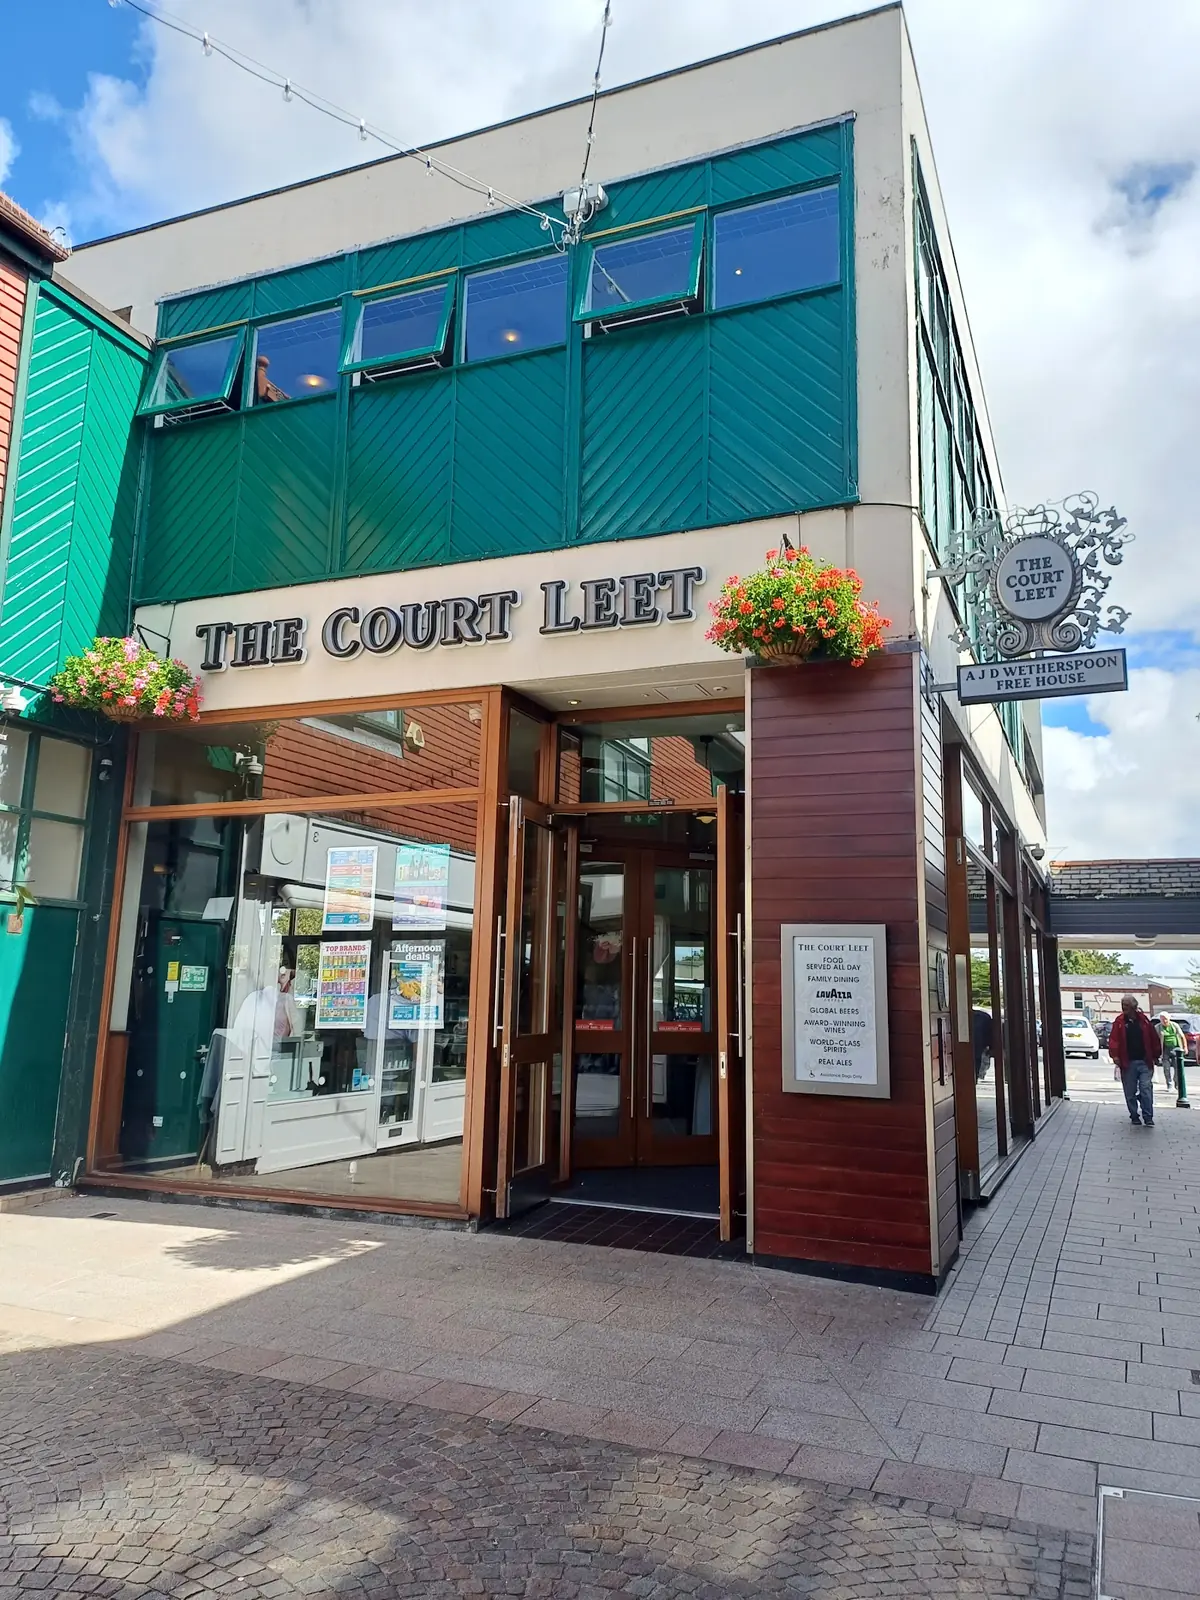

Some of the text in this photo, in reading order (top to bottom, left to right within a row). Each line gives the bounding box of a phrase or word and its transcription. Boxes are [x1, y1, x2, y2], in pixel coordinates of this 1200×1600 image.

[1016, 556, 1053, 572] THE
[1006, 570, 1065, 589] COURT
[1015, 586, 1057, 602] LEET
[195, 566, 703, 671] THE COURT LEET
[966, 656, 1118, 681] A J D WETHERSPOON
[996, 672, 1086, 691] FREE HOUSE
[395, 944, 442, 952] Afternoon
[848, 944, 869, 952] LEET
[405, 953, 430, 961] deals
[839, 1007, 860, 1015] BEERS
[804, 1019, 866, 1028] AWARD-WINNING
[809, 1038, 861, 1047] WORLD-CLASS
